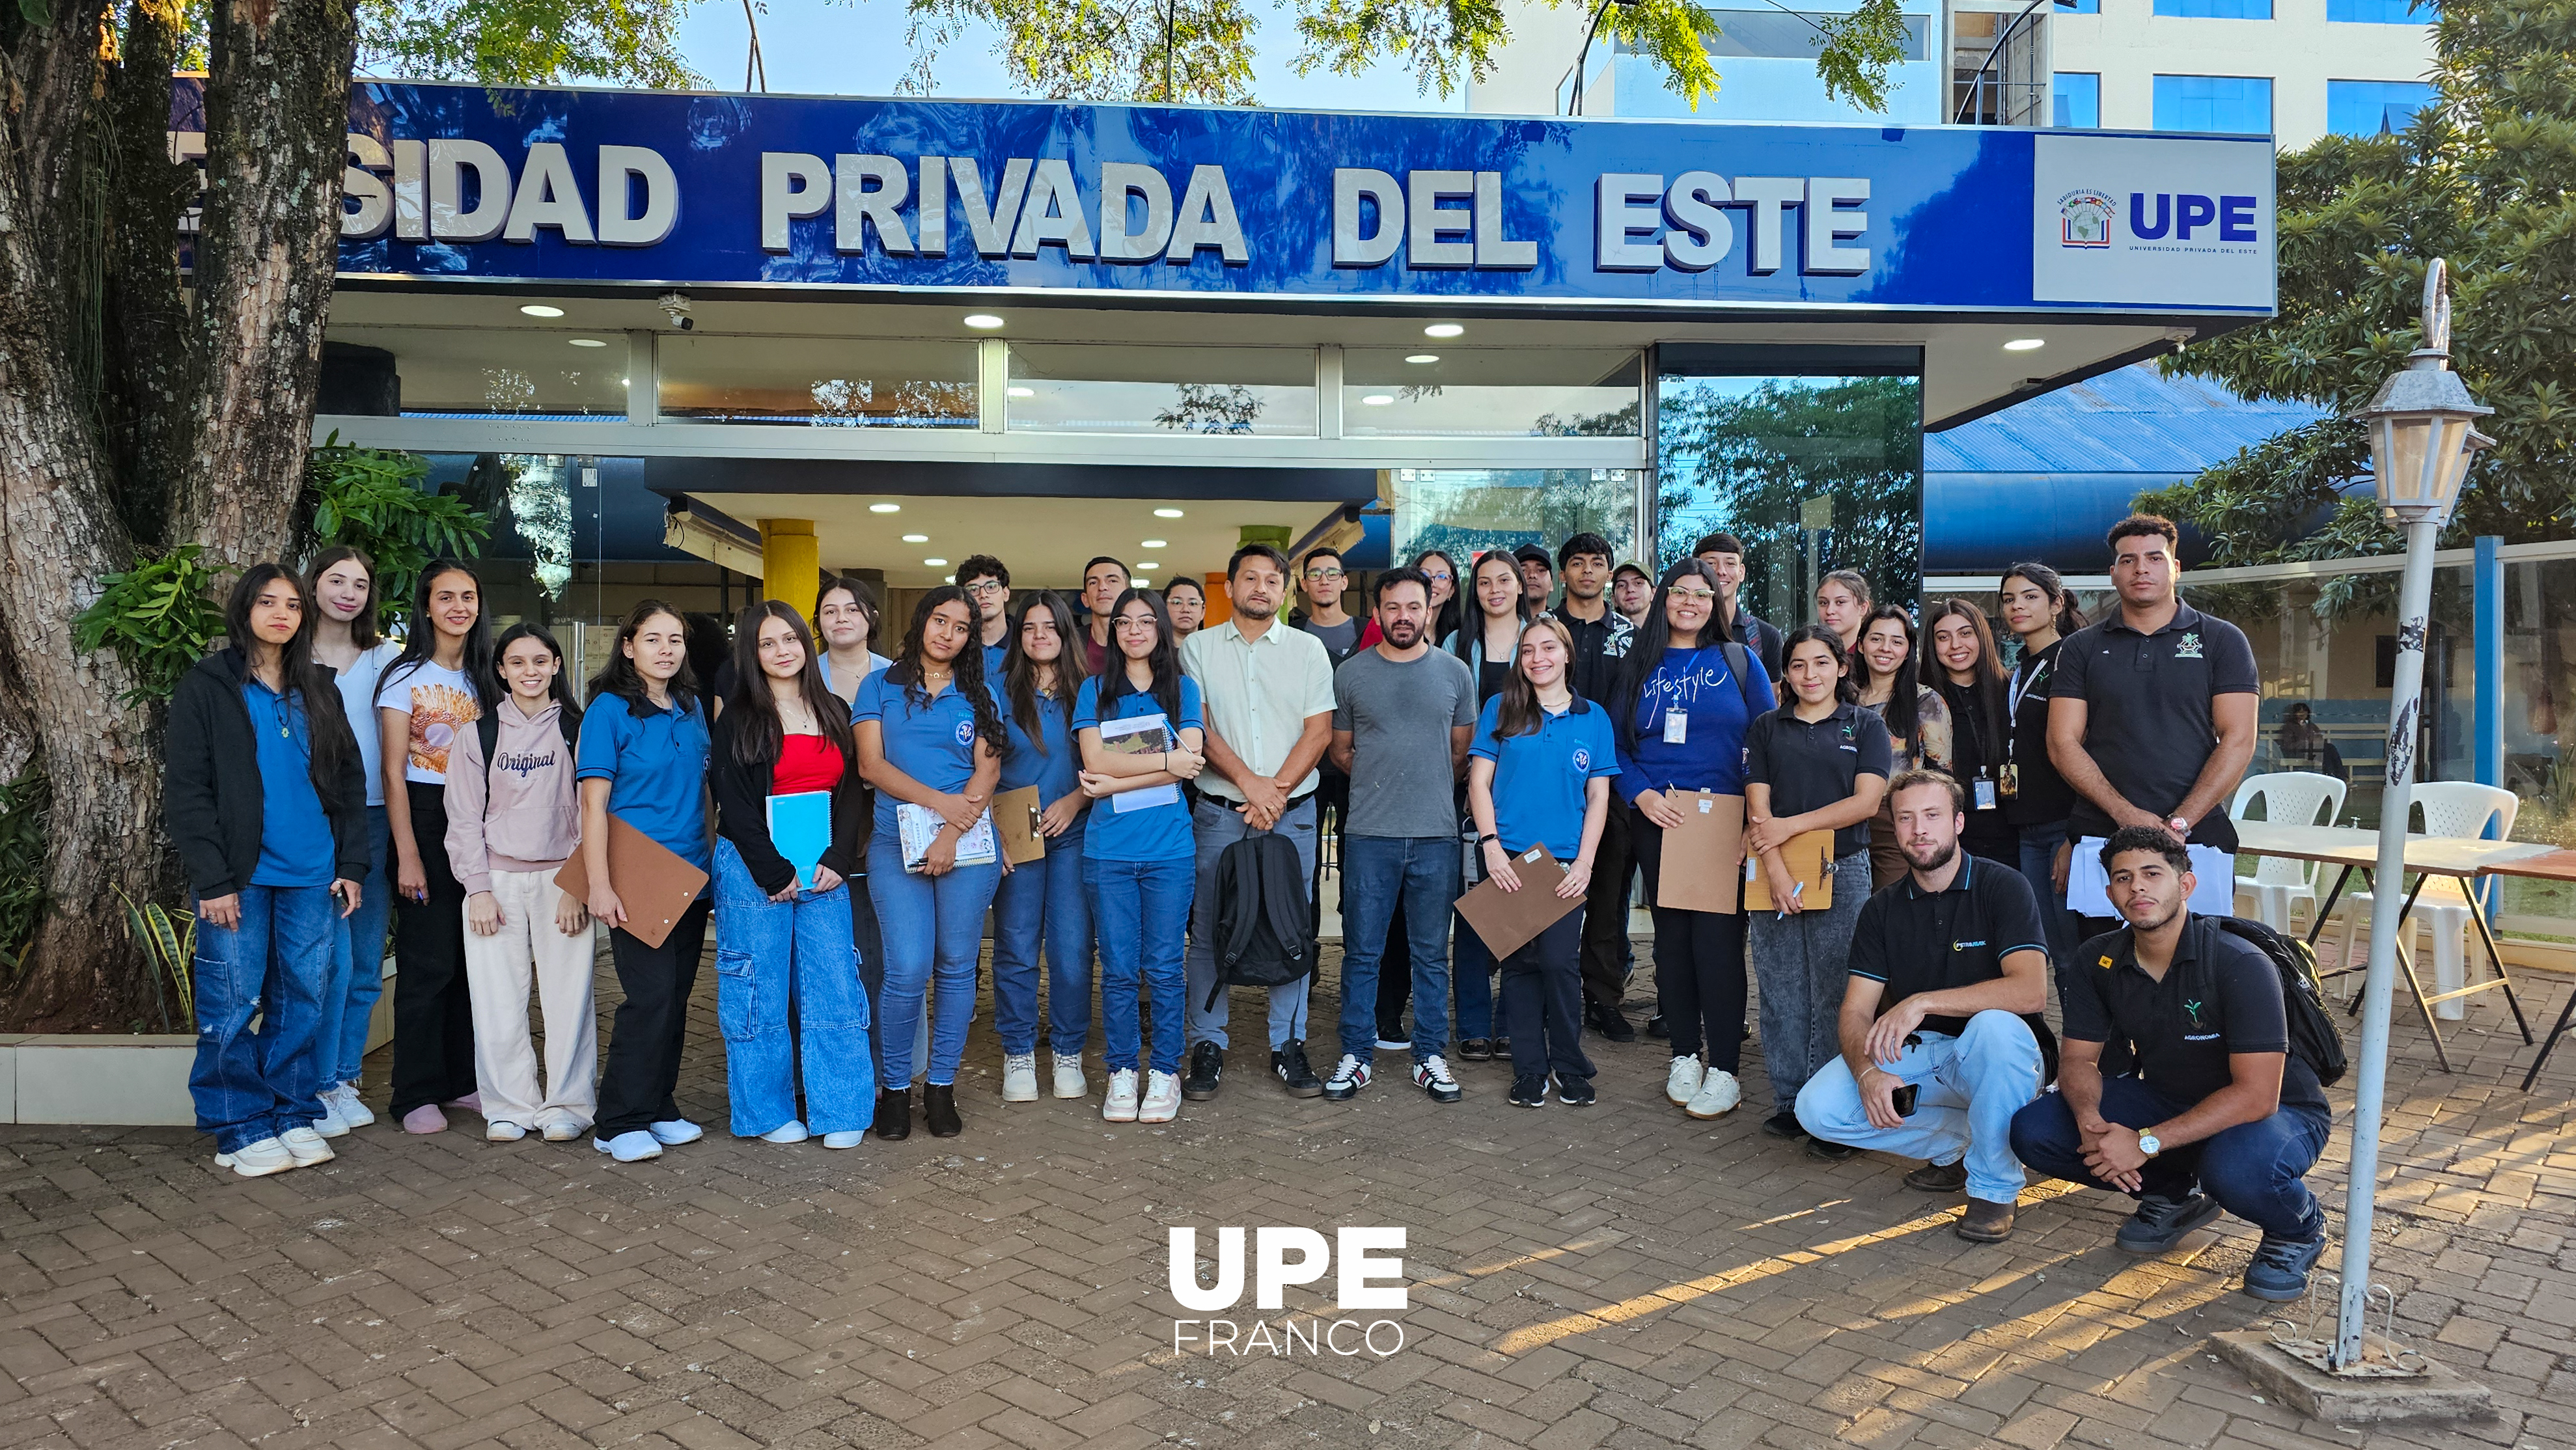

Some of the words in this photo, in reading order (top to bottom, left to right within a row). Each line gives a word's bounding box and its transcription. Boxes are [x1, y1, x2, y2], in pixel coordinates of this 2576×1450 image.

[760, 152, 1249, 266] PRIVADA
[1332, 167, 1538, 270] DEL
[1594, 171, 1871, 277] ESTE
[2057, 189, 2085, 205] SABIDURIA
[2094, 189, 2116, 206] LIBERTAD
[2130, 193, 2257, 241] UPE
[1643, 666, 1728, 729] Lifestyle
[497, 750, 556, 778] Original
